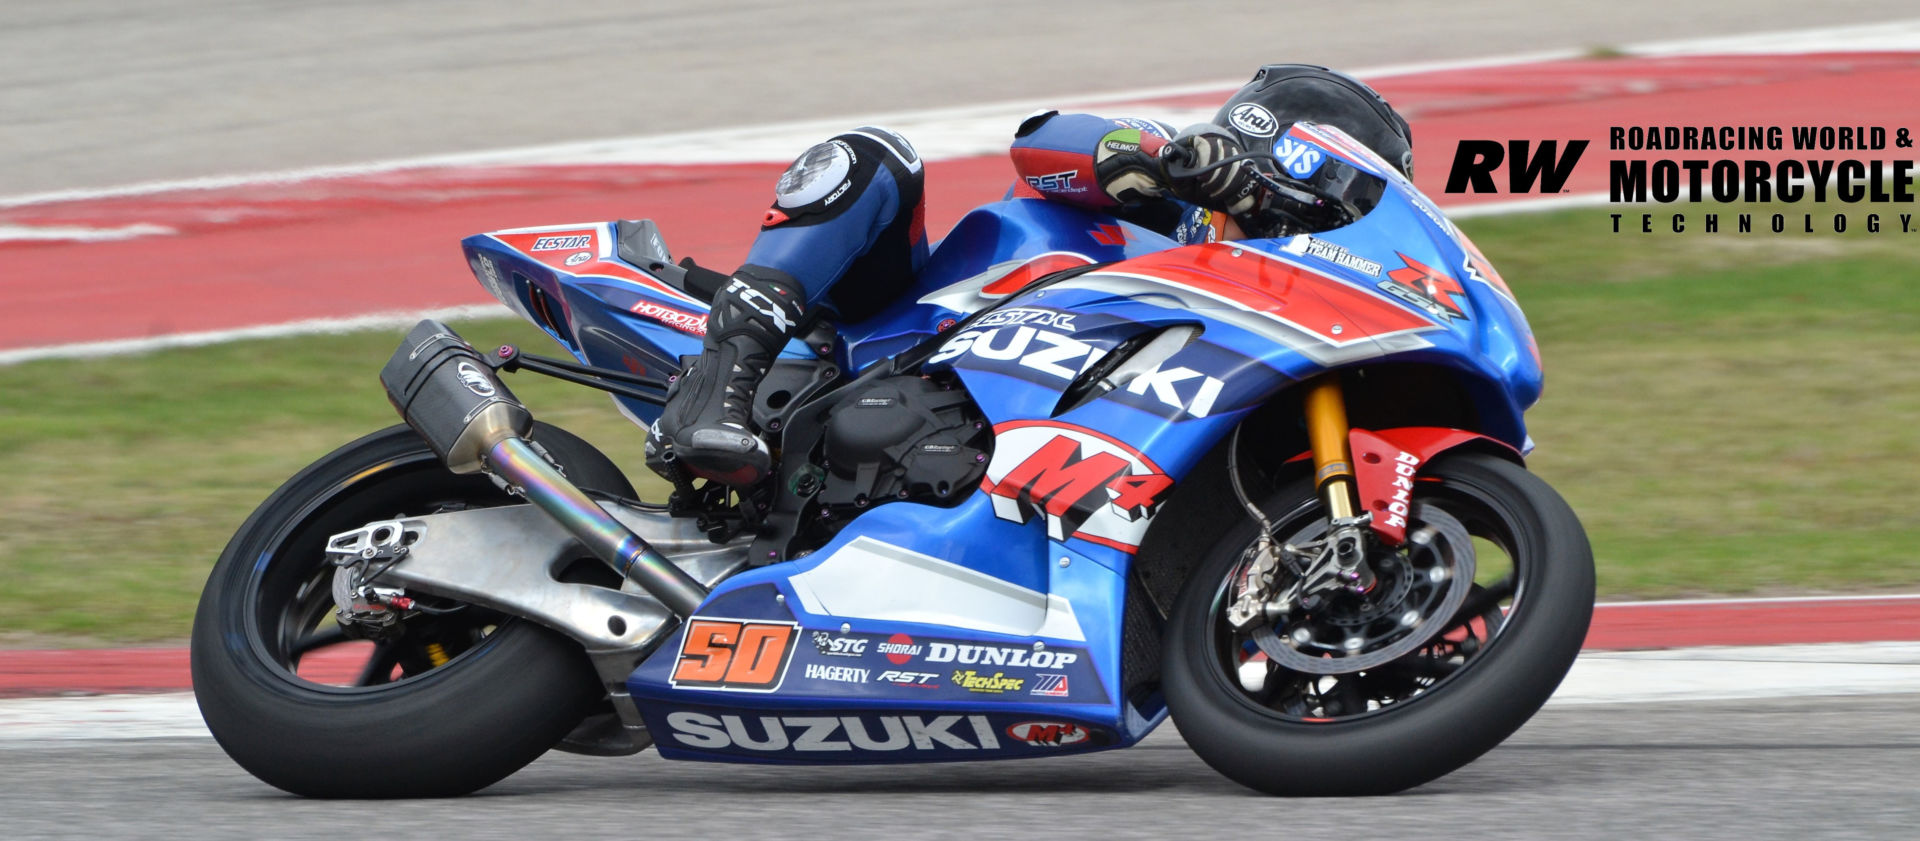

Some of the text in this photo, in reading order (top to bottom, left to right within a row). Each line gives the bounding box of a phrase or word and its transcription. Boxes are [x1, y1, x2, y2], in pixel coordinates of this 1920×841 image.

[1231, 107, 1273, 130] Arai
[1107, 141, 1138, 152] HELIMOT
[531, 235, 592, 252] ECSTAR
[1307, 243, 1382, 277] TEAM HAMMER
[727, 278, 796, 333] TCX
[990, 434, 1176, 542] M4
[1384, 451, 1420, 528] DUNLOP
[673, 620, 793, 684] 50
[829, 638, 1078, 669] STG SHORAI DUNLOP
[805, 664, 871, 684] HAGERTY
[876, 670, 940, 684] RST
[667, 711, 1001, 751] SUZUKI
